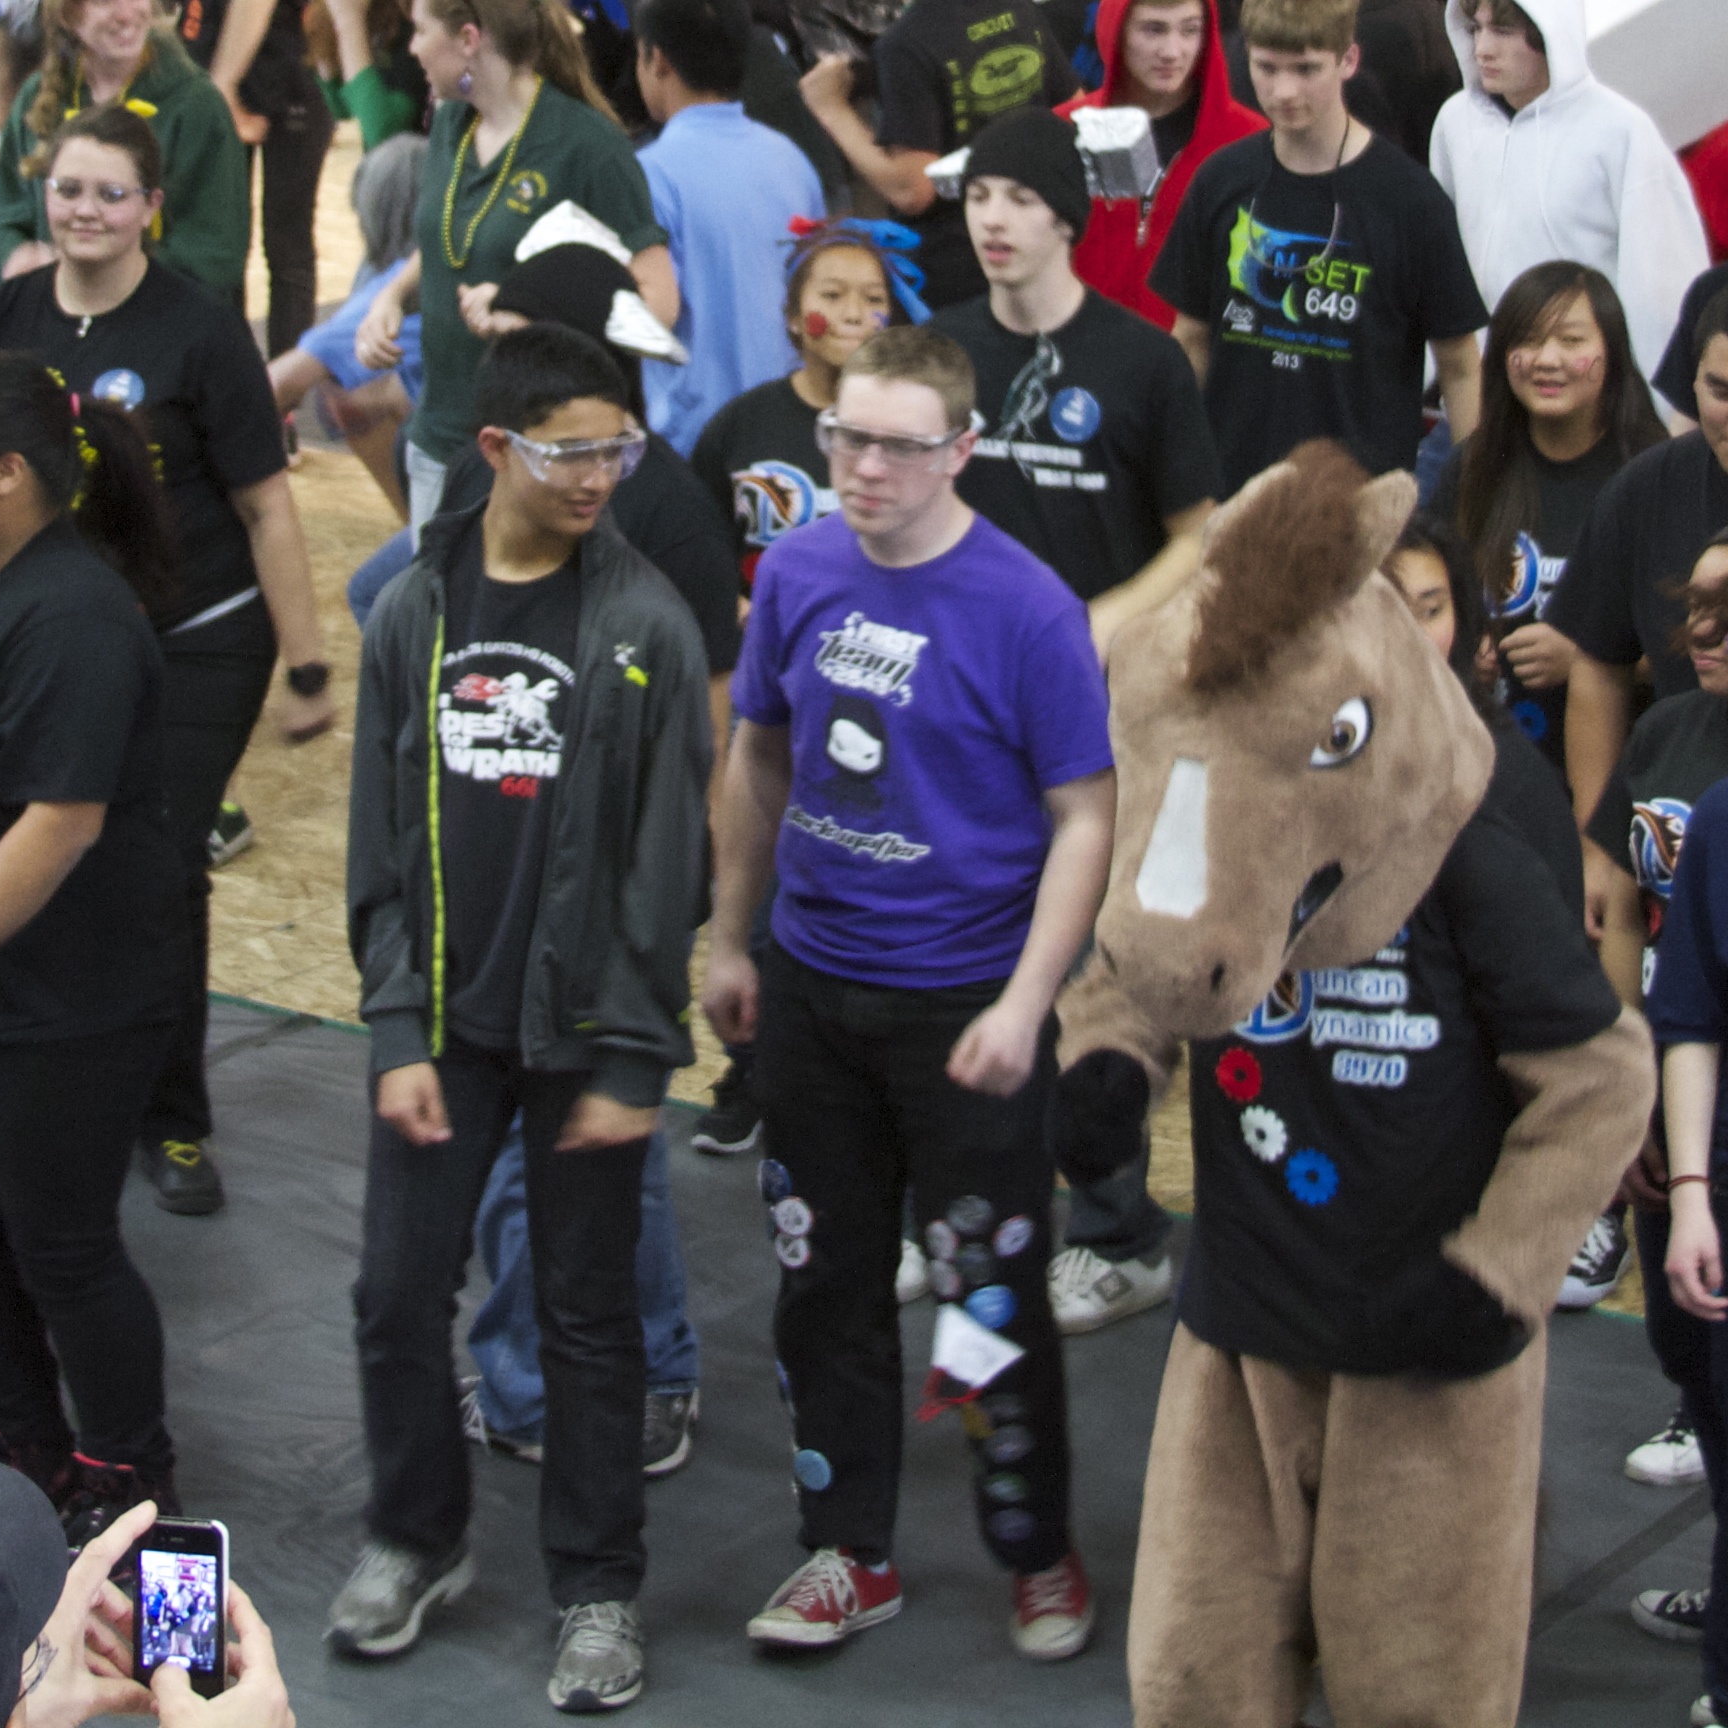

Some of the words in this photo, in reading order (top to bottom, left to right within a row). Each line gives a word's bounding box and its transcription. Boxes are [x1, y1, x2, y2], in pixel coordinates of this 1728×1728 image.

[1305, 255, 1371, 294] SET
[1305, 287, 1359, 322] 649
[444, 747, 561, 780] WRATH
[1334, 1054, 1406, 1083] 3970
